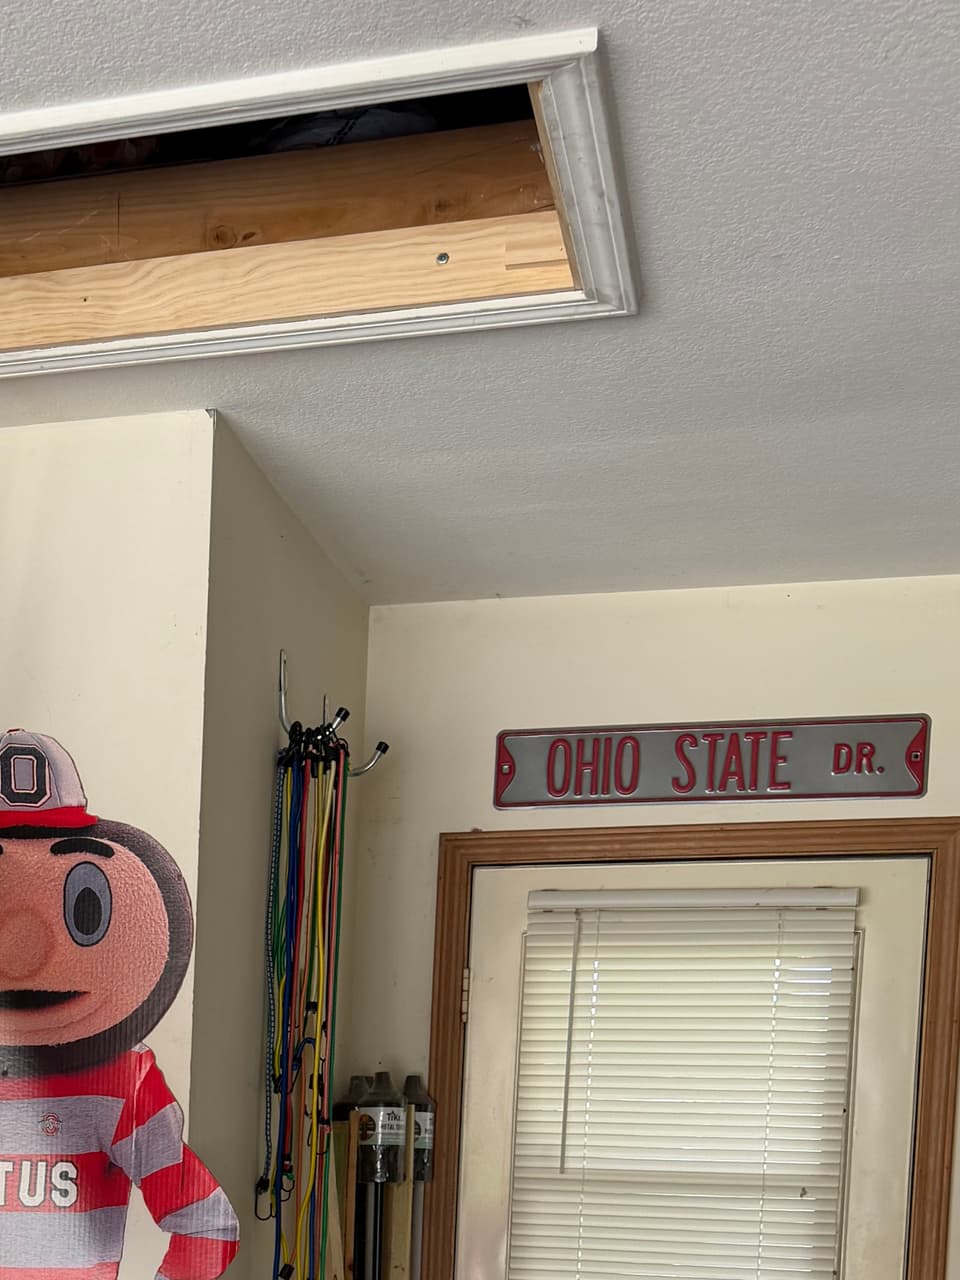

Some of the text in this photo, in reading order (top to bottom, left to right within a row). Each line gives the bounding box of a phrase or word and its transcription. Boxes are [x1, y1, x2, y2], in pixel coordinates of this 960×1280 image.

[546, 731, 886, 798] OHIO STATE DR.
